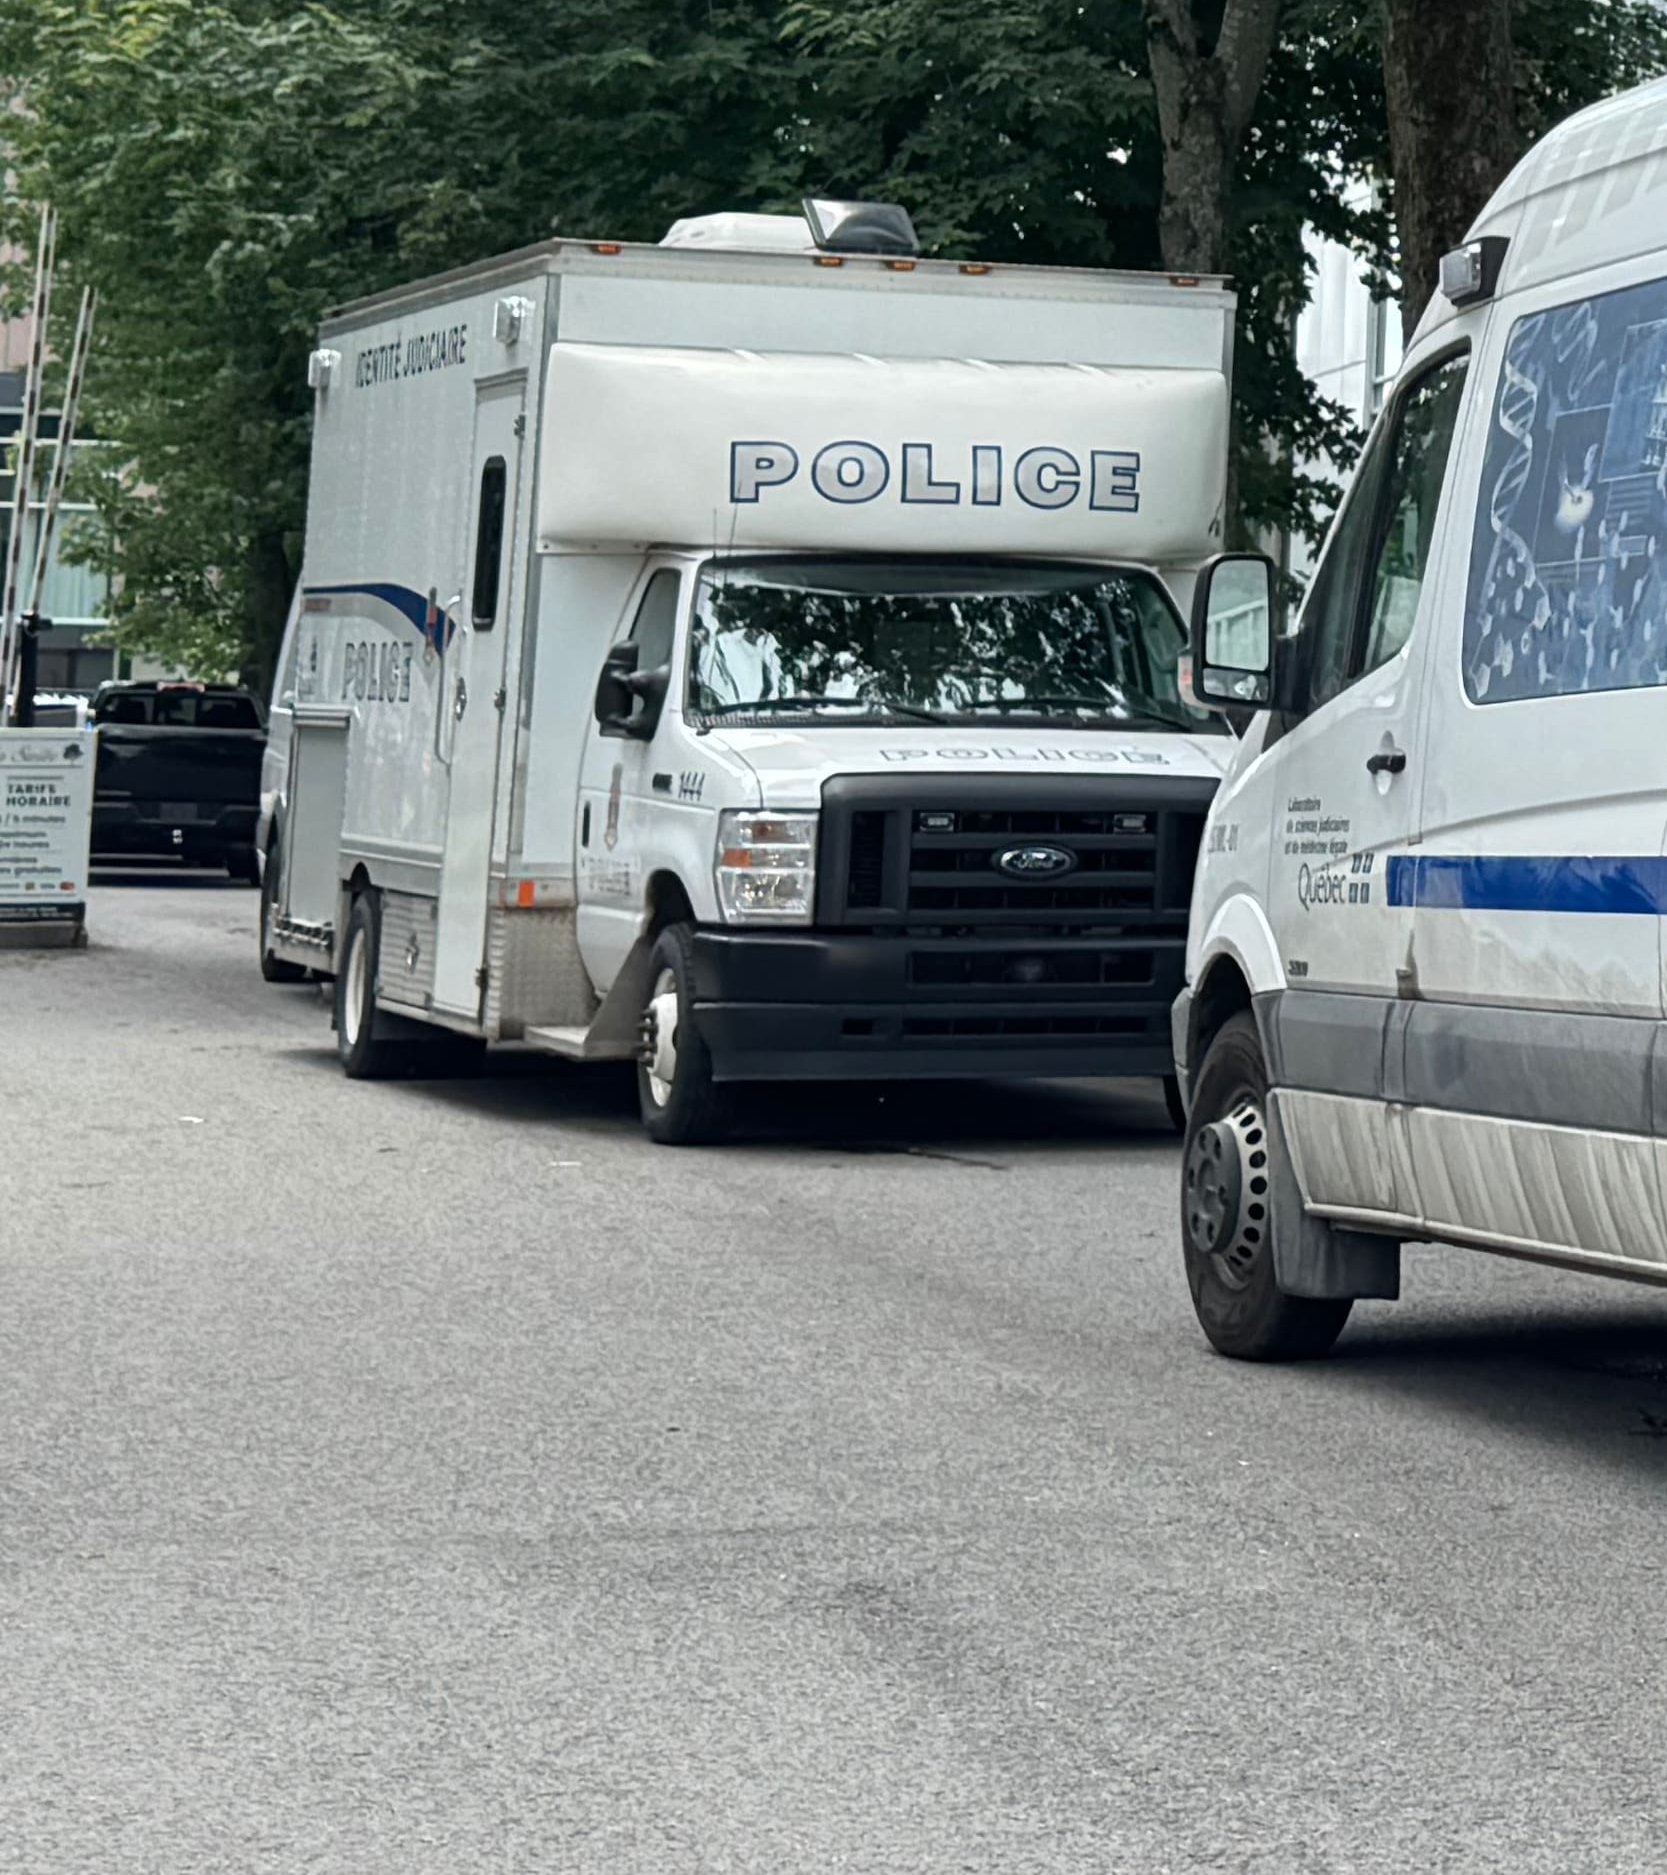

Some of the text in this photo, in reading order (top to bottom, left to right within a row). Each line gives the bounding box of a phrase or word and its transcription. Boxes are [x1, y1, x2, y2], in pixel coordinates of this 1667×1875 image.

[403, 324, 468, 378] JUDICIAIRE
[730, 439, 1141, 513] POLICE
[342, 640, 415, 703] POLICE
[879, 747, 1171, 766] POLICE
[678, 771, 706, 802] 1444
[1298, 862, 1347, 913] Québec
